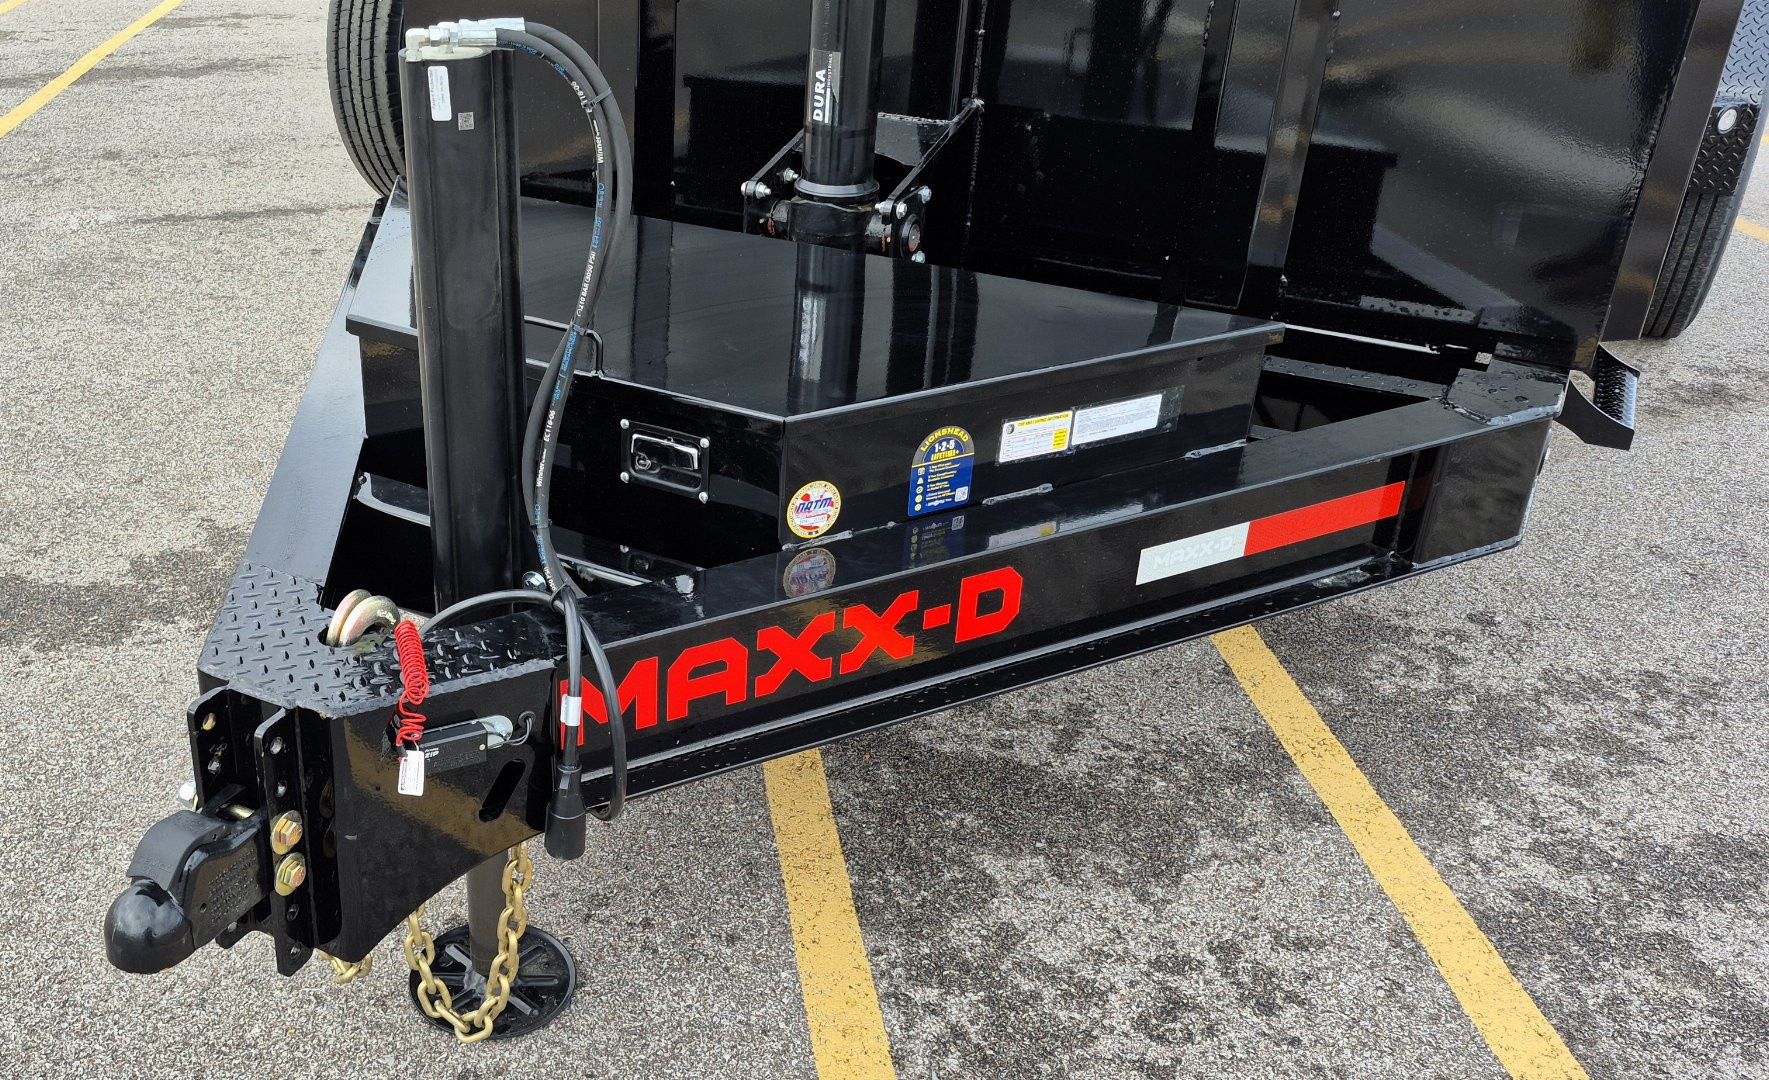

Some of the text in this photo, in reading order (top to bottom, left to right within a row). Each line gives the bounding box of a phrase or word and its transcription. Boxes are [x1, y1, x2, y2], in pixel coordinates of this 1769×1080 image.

[826, 54, 834, 88] INDUSTRIALS
[812, 69, 827, 122] DURA
[920, 427, 969, 452] LIONSHEAD
[536, 461, 545, 488] Winner
[1153, 536, 1235, 570] MAXX-D
[559, 566, 1022, 749] MAXX-D
